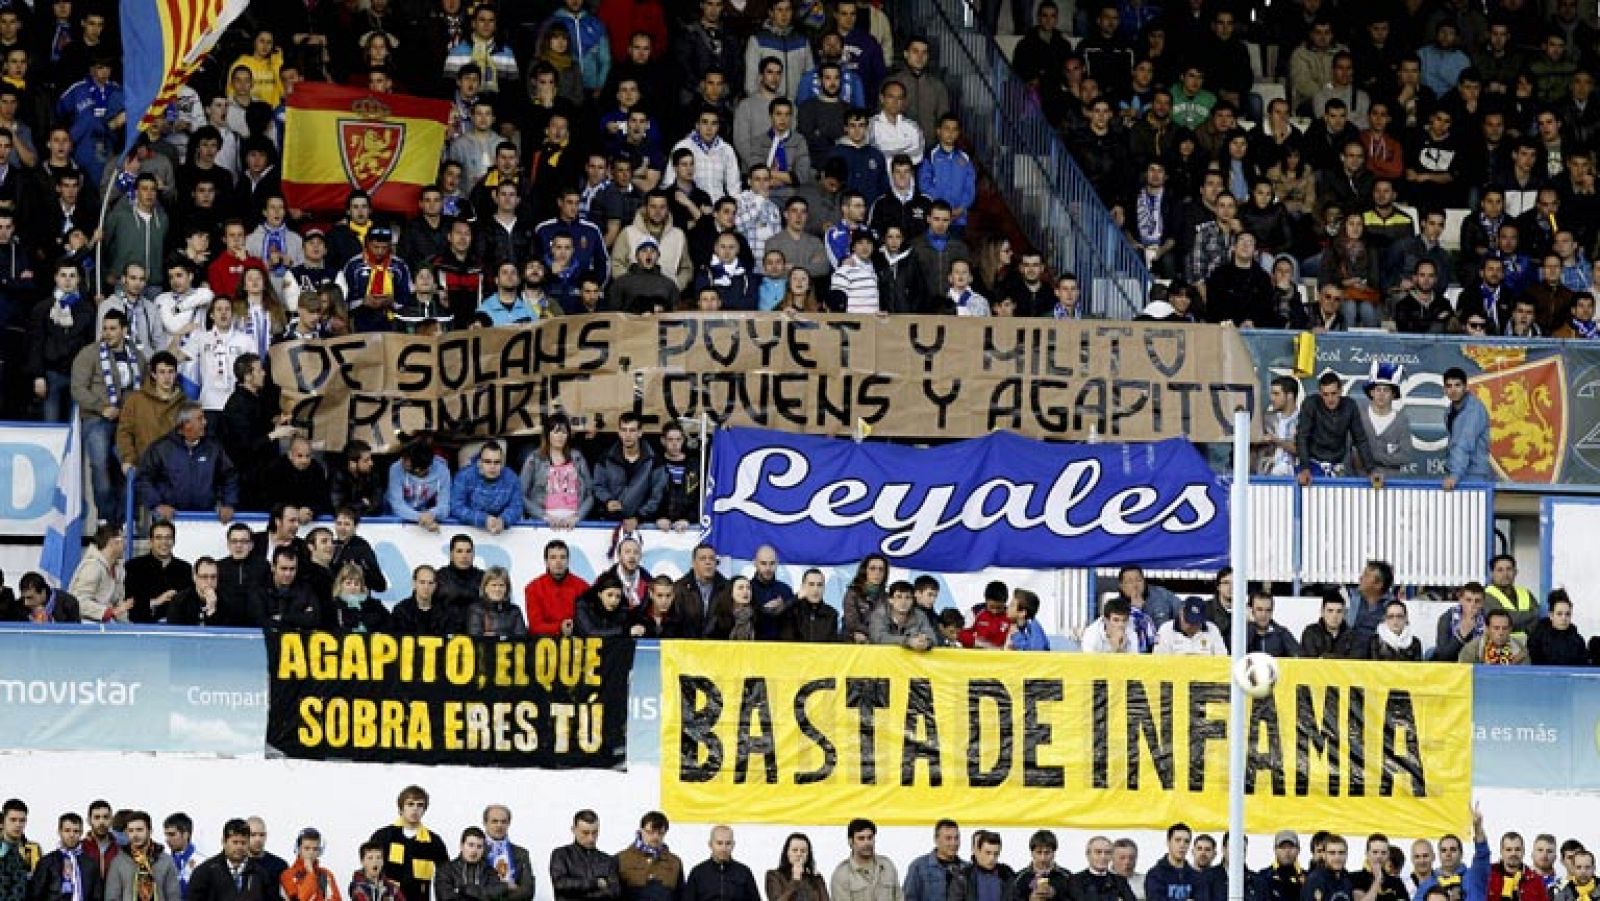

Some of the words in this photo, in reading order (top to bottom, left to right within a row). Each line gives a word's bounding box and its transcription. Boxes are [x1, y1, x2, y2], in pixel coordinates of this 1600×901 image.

[289, 339, 366, 394] DE
[657, 318, 861, 368] POYET
[910, 322, 946, 372] Y
[983, 326, 1187, 377] MILITO
[291, 395, 323, 440] A
[922, 378, 961, 429] Y
[987, 377, 1255, 436] AGAPITO
[712, 446, 1217, 557] Leyales
[496, 642, 530, 687] EL
[534, 636, 603, 691] QUE
[299, 697, 432, 750] SOBRA
[445, 701, 539, 754] ERES
[550, 693, 603, 755] TÚ
[678, 675, 943, 787] BASTA
[966, 678, 1065, 788] DE
[1092, 679, 1427, 798] INFAMIA
[1491, 727, 1513, 741] es
